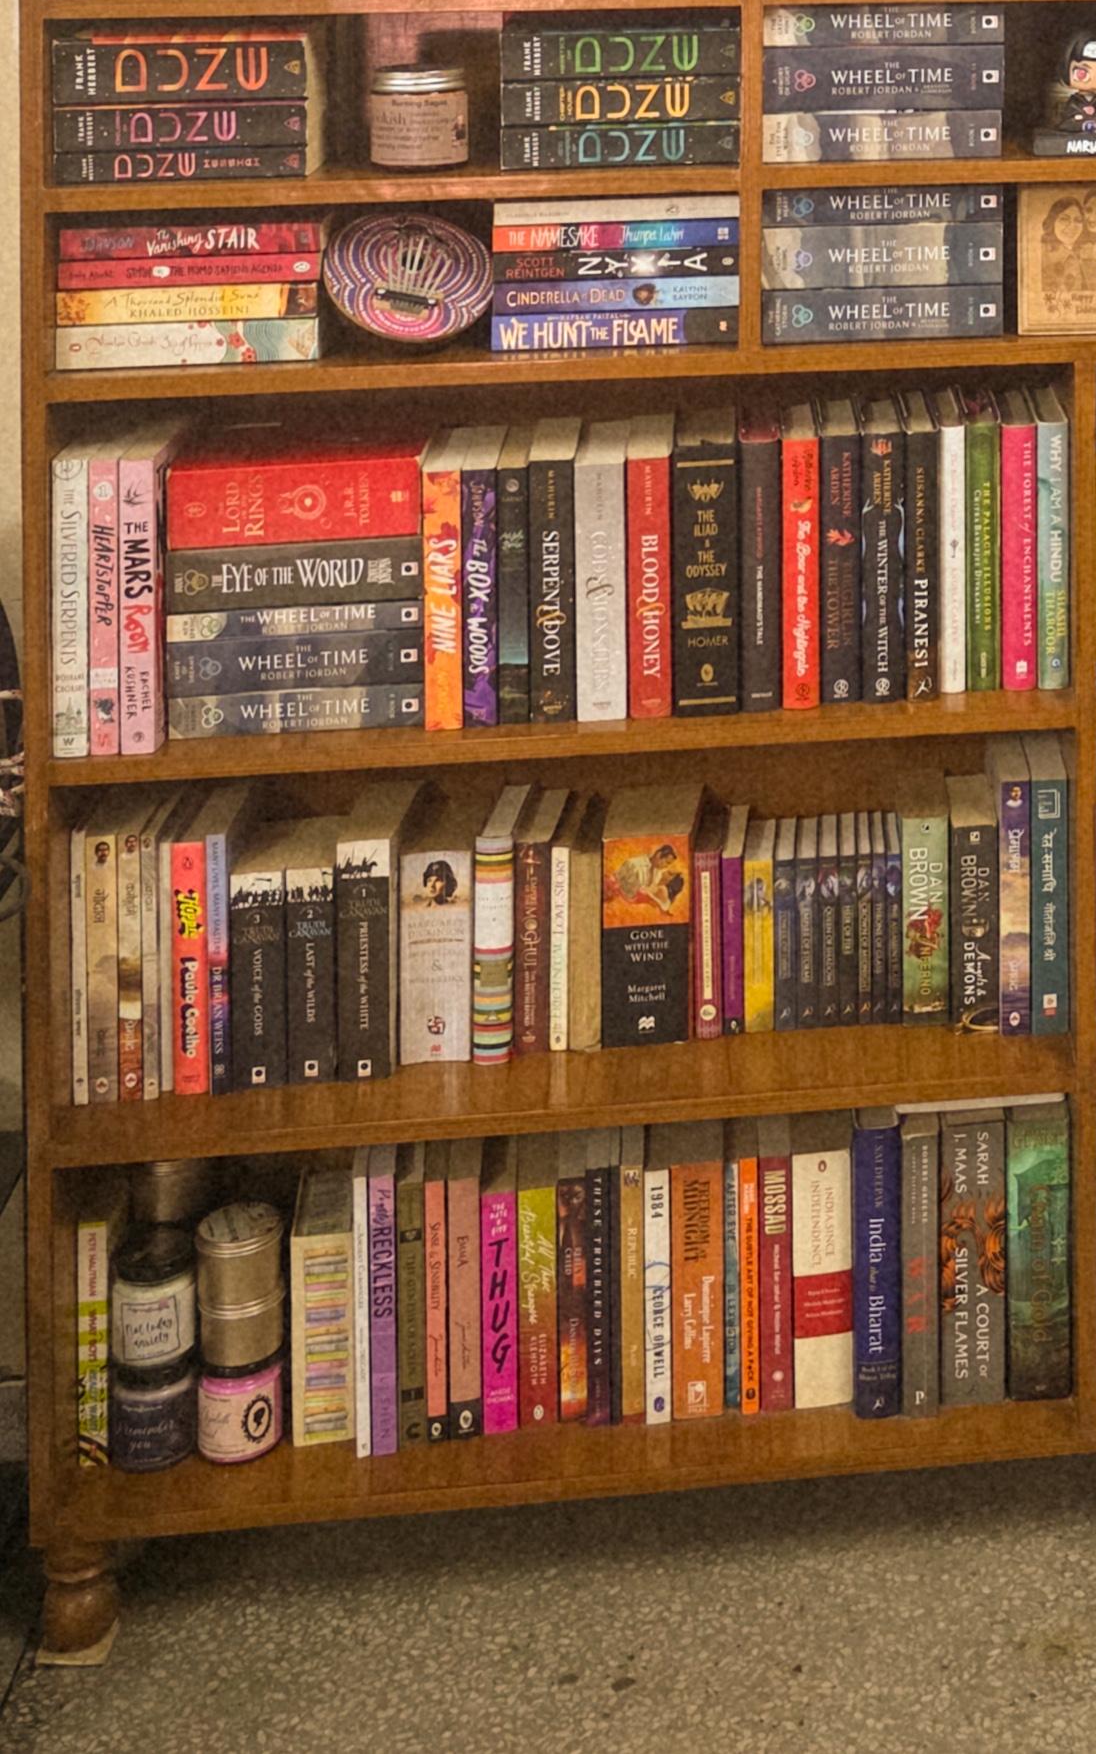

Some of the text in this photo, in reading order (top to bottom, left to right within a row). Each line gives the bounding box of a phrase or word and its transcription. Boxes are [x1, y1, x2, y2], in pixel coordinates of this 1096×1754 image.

[75, 54, 83, 90] FRANK
[87, 48, 96, 95] HERBERT
[831, 70, 892, 84] WHEEL
[910, 68, 953, 82] TIME
[832, 87, 871, 95] ROBERT
[874, 86, 911, 94] JORDAN
[207, 228, 259, 249] STAIR
[506, 268, 564, 278] REINTGEN
[515, 259, 553, 267] SCOTT
[500, 320, 528, 348] WE
[533, 320, 589, 345] HUNT
[591, 327, 608, 340] THE
[124, 522, 148, 535] THE
[124, 540, 152, 600] MARS
[221, 558, 363, 594] EYE OF THE WORLD
[686, 564, 727, 578] ODYSSEY
[429, 538, 457, 654] NINE LIARS
[915, 579, 928, 667] PIRANESI
[687, 636, 729, 647] HOMER
[910, 848, 928, 920] BROWN
[629, 929, 664, 940] GONE
[630, 951, 663, 962] WIND
[650, 1186, 663, 1218] 1984
[763, 1170, 785, 1235] MOSSAD
[372, 1226, 393, 1319] RECKLESS
[488, 1238, 512, 1372] THUG
[955, 1247, 969, 1380] SILVER FLAMES
